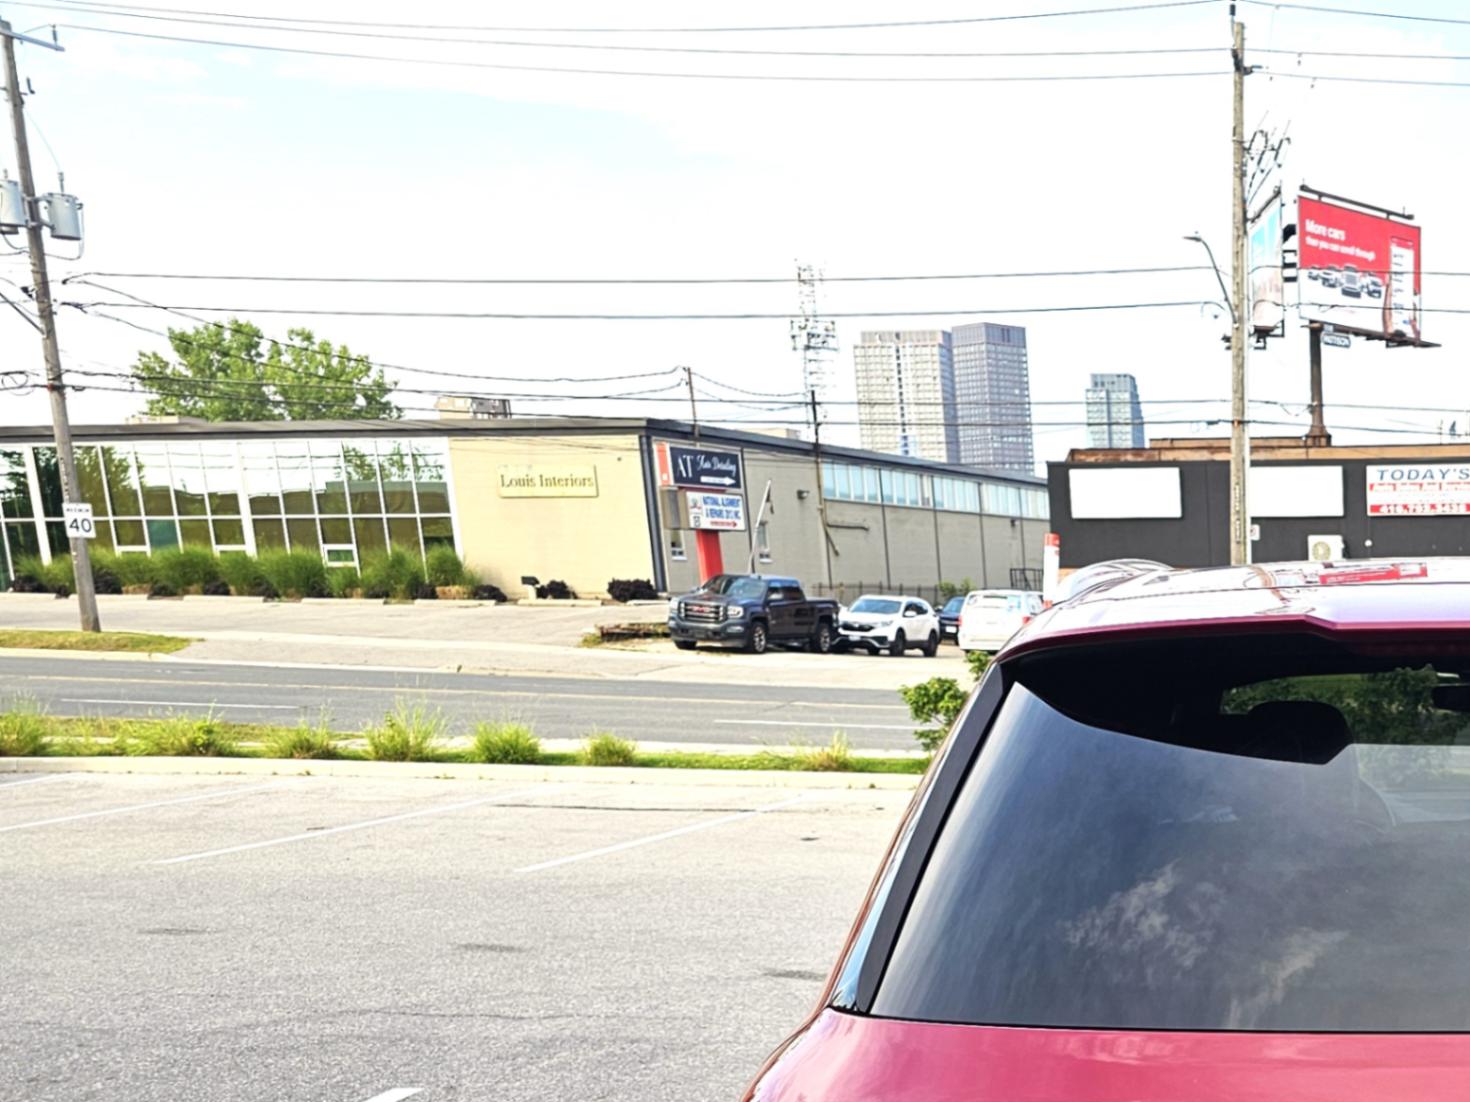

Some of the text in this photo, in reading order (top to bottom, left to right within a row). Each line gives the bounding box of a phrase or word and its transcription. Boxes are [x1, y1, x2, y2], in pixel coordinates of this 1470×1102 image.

[500, 473, 595, 488] Louis Interiors
[1377, 468, 1470, 481] TODAY'S
[69, 517, 92, 533] 40
